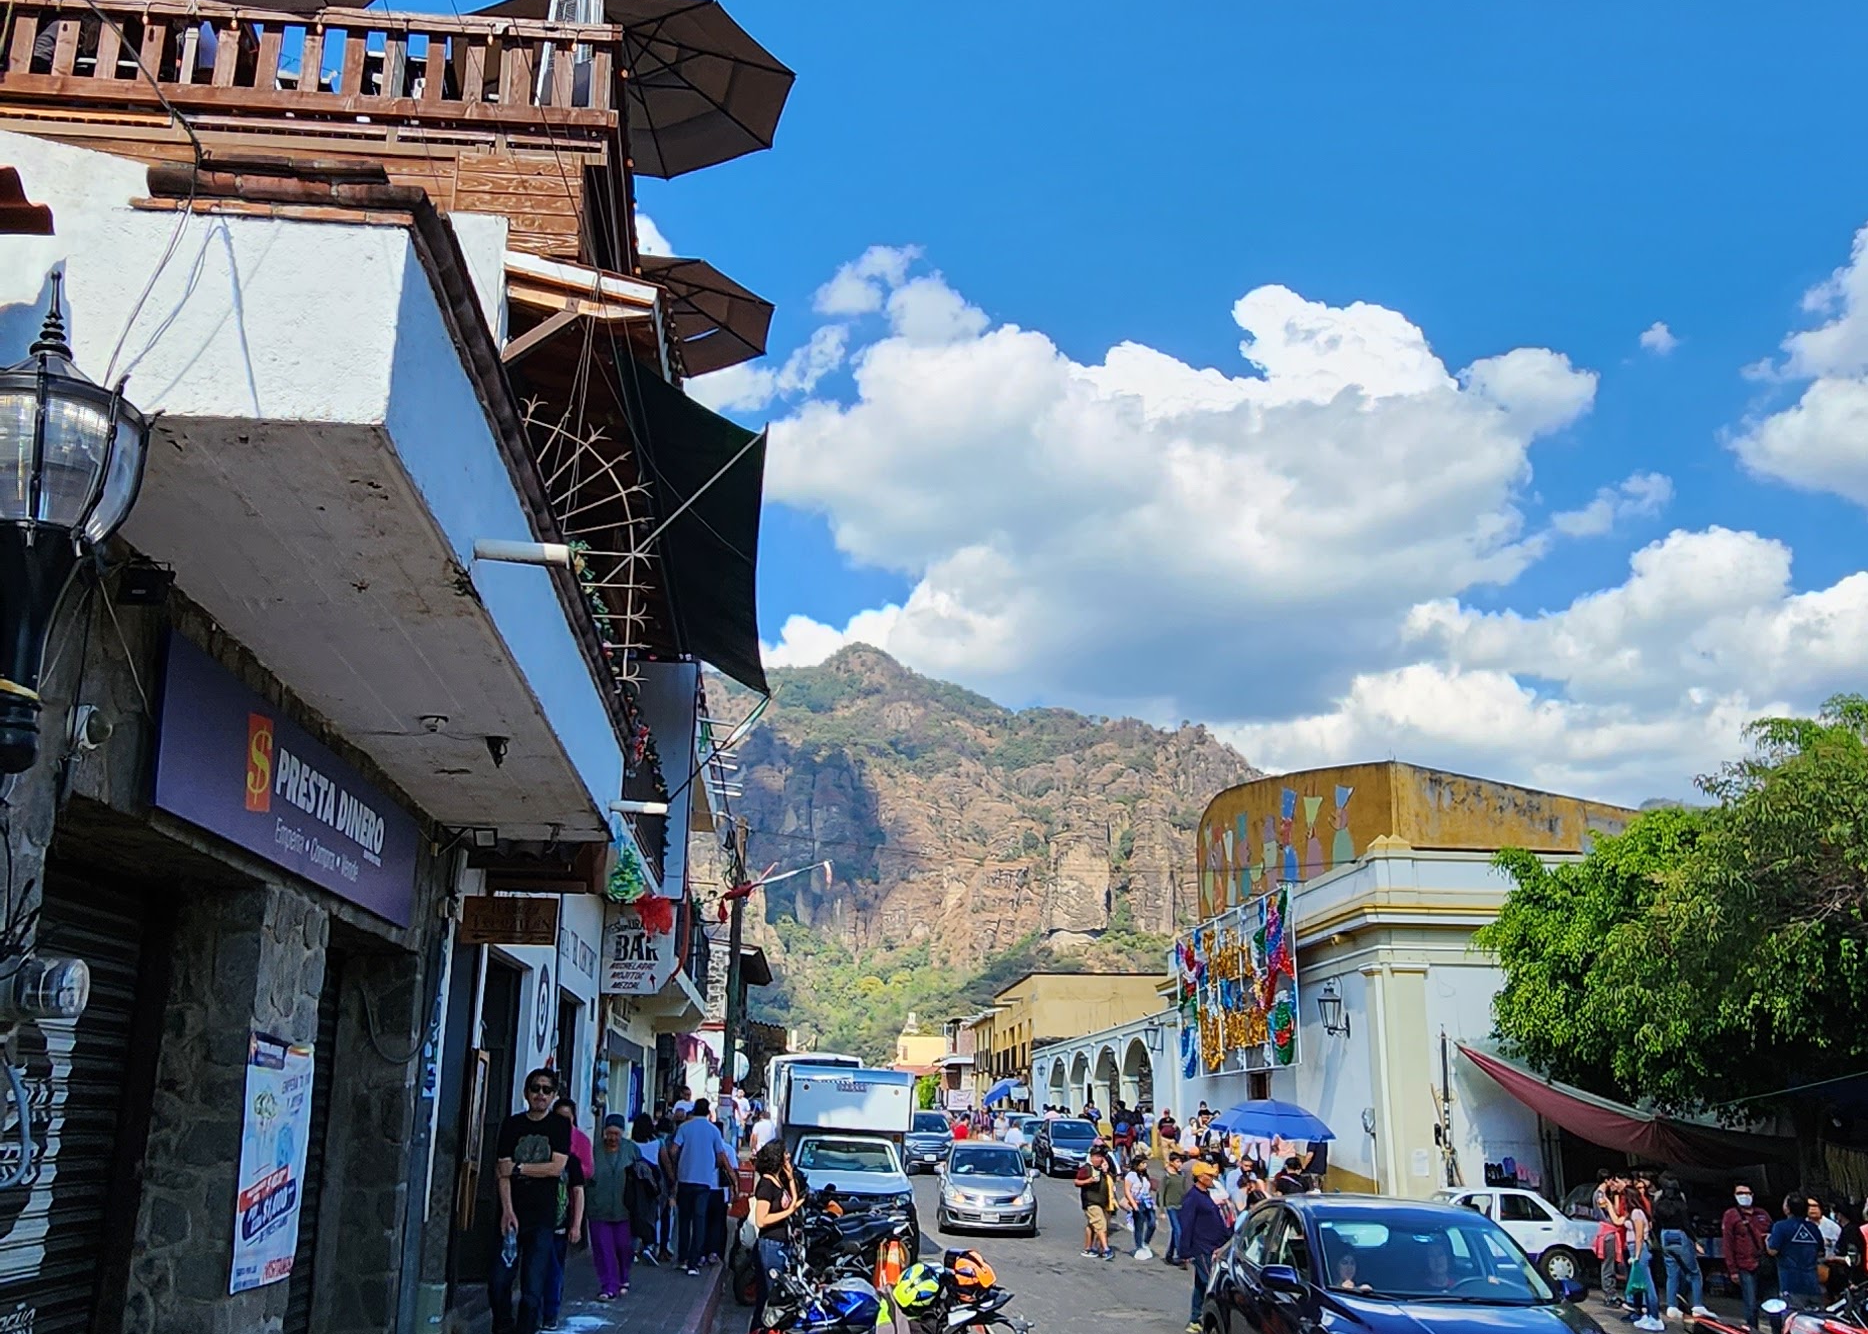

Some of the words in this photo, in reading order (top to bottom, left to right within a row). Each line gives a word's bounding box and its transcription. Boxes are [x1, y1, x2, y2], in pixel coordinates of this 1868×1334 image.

[275, 747, 336, 827] PRESTA
[335, 788, 386, 855] DINERO
[613, 932, 659, 961] BAR
